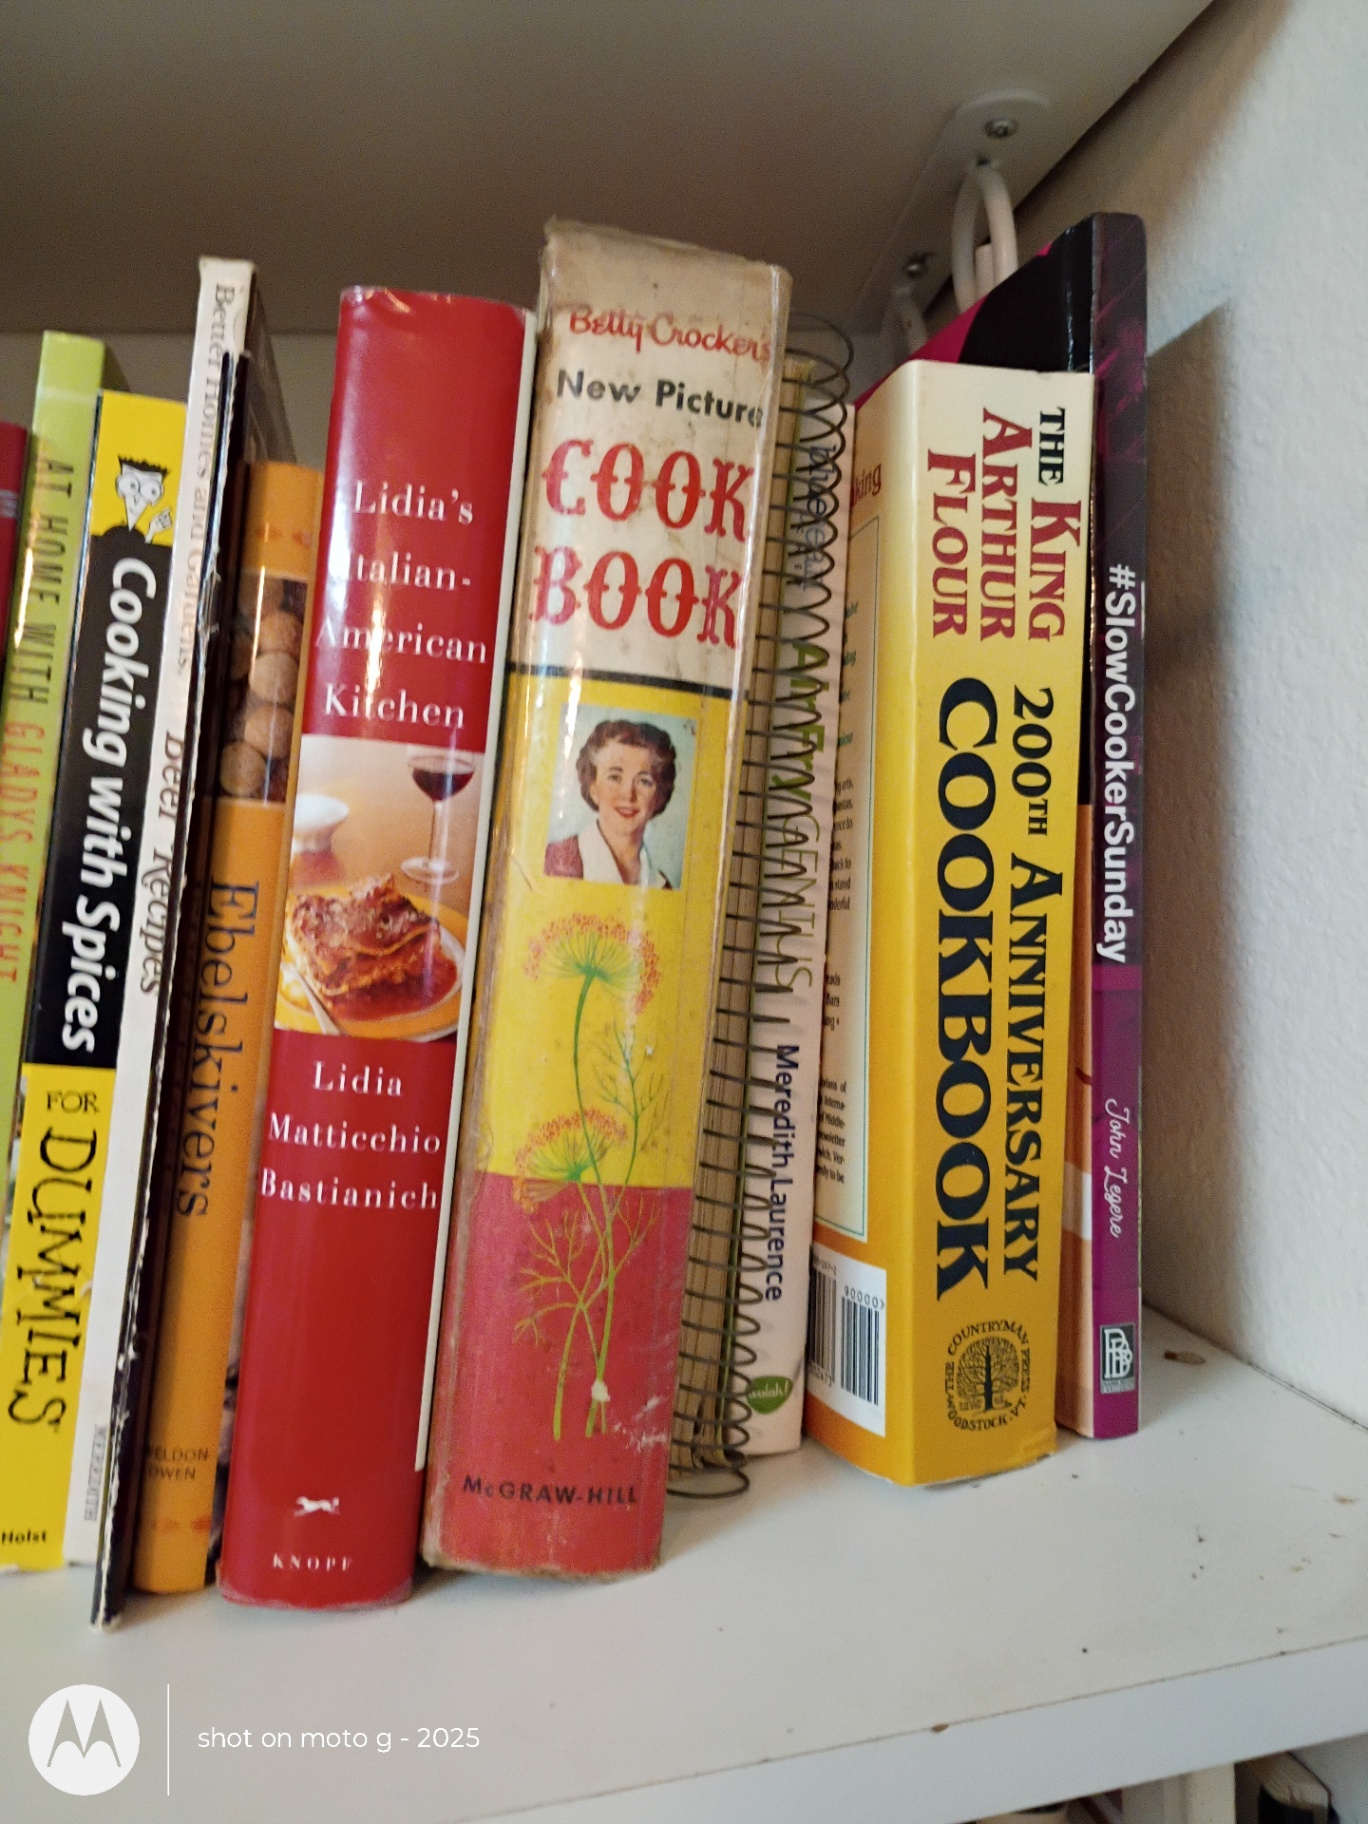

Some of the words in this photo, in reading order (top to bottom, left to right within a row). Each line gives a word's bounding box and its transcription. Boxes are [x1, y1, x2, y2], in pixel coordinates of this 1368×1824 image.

[568, 305, 643, 353] Betty
[651, 313, 771, 365] Crocker's
[556, 369, 641, 403] New
[655, 378, 764, 429] Picture
[1037, 406, 1066, 486] THE
[36, 458, 75, 498] AT
[354, 479, 474, 525] Lidia's
[541, 438, 755, 543] COOK
[980, 406, 1033, 642] ARTHUR
[29, 514, 69, 605] HOME
[351, 550, 471, 592] talian-
[927, 448, 977, 639] FLOUR
[1028, 498, 1082, 642] KING
[315, 614, 487, 664] American
[529, 545, 744, 650] BOOK
[9, 623, 57, 704] WITH
[82, 557, 157, 767] Cooking
[324, 682, 465, 729] Kitchen
[0, 721, 45, 844] GLADYS
[1011, 684, 1055, 836] 200TH
[1096, 562, 1137, 964] #SlowCookerSunday
[80, 776, 132, 889] with
[62, 893, 121, 1054] Spices
[935, 677, 998, 1302] COOKBOOK
[177, 880, 260, 1218] Ebelskivers
[313, 1060, 403, 1097] Lidia
[1003, 852, 1063, 1282] ANNIVERSARY
[46, 1089, 99, 1114] FOR
[268, 1111, 441, 1154] Matticchio
[770, 1044, 801, 1169] Meredith
[1104, 1098, 1130, 1159] John
[260, 1167, 438, 1210] Bastianich
[8, 1126, 98, 1434] DUMMIES
[765, 1177, 794, 1302] Laurence
[947, 1319, 1030, 1356] COUNTRYMAN
[149, 1445, 209, 1461] ELDON
